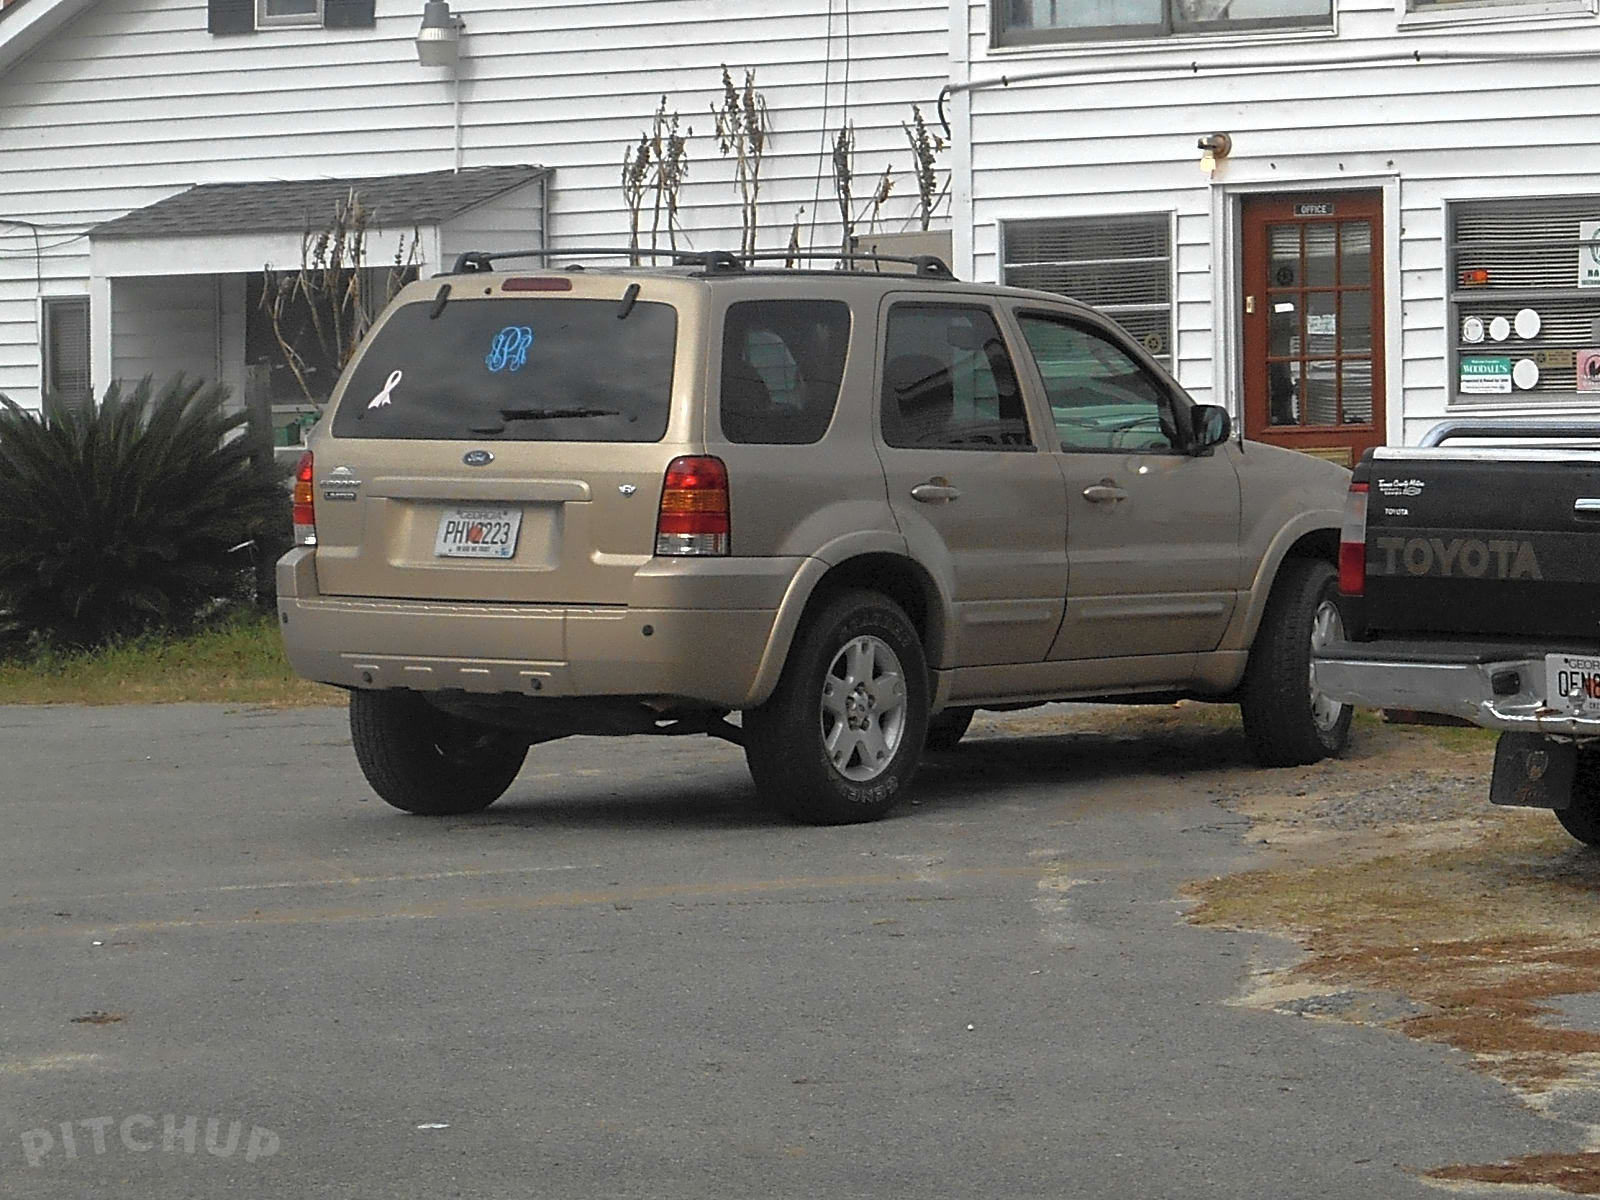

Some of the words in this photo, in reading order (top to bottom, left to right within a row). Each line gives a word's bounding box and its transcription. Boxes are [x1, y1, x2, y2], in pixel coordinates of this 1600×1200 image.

[1301, 204, 1327, 214] OFFICE
[1385, 508, 1408, 516] TOYOTA
[1377, 537, 1543, 579] TOYOTA
